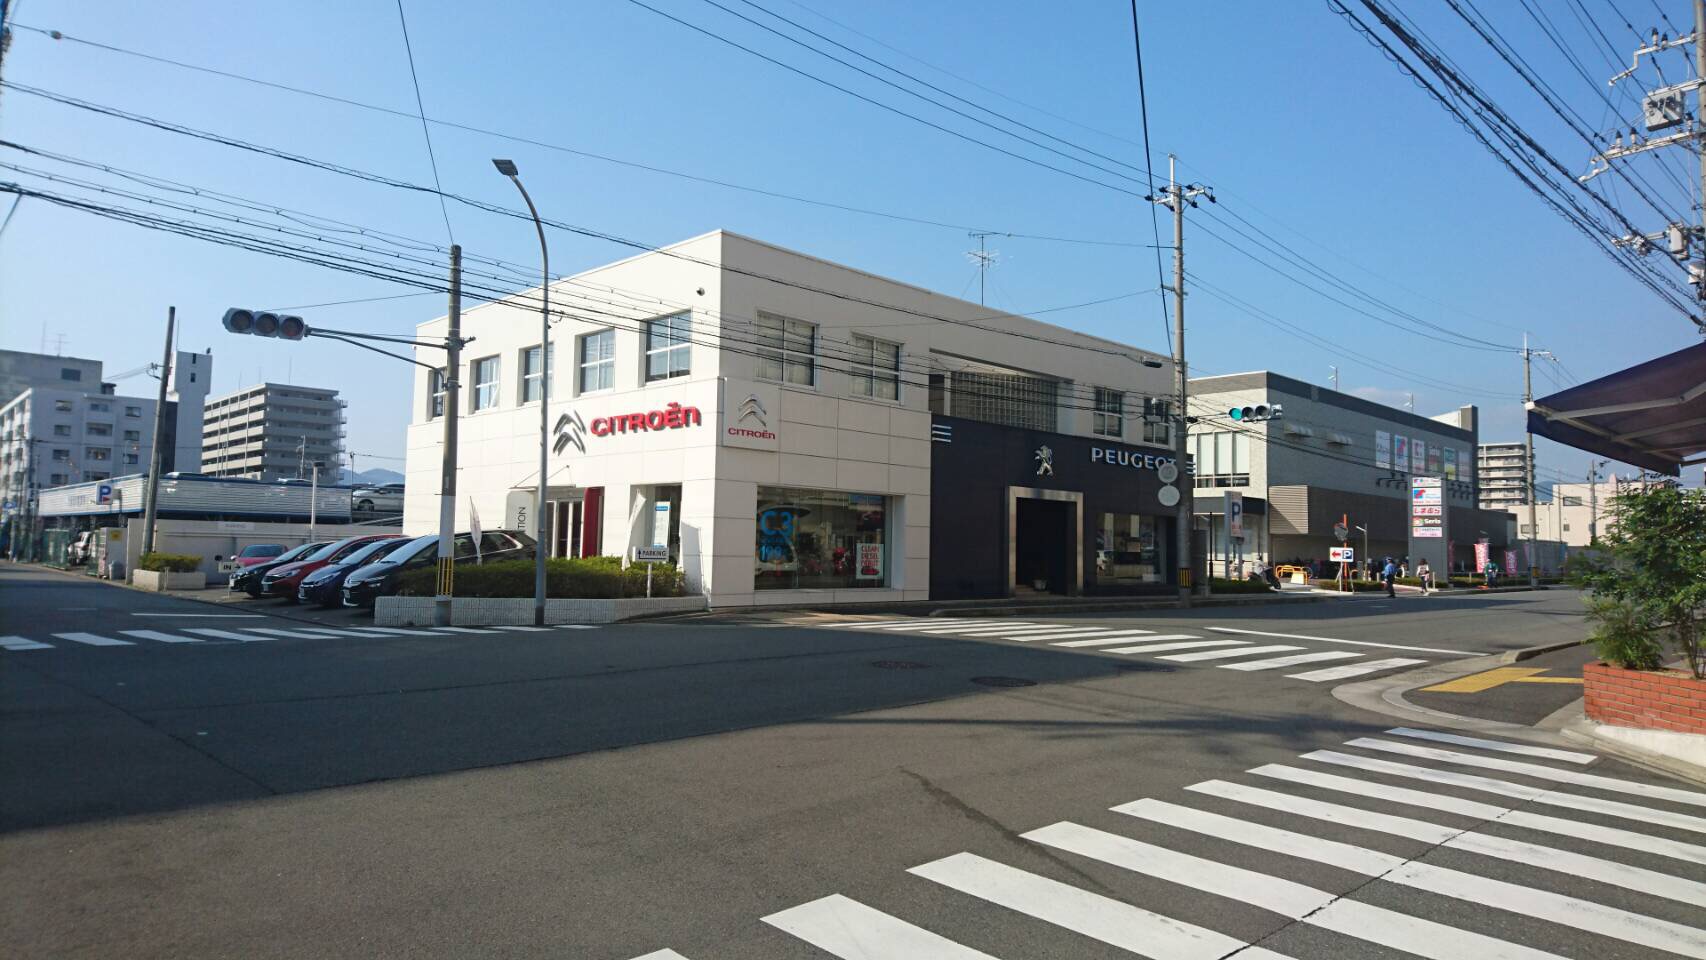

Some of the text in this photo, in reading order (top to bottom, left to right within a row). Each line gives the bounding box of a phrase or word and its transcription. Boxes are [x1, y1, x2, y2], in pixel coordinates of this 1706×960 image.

[99, 485, 112, 502] P
[1232, 502, 1241, 522] P
[1344, 550, 1351, 559] P
